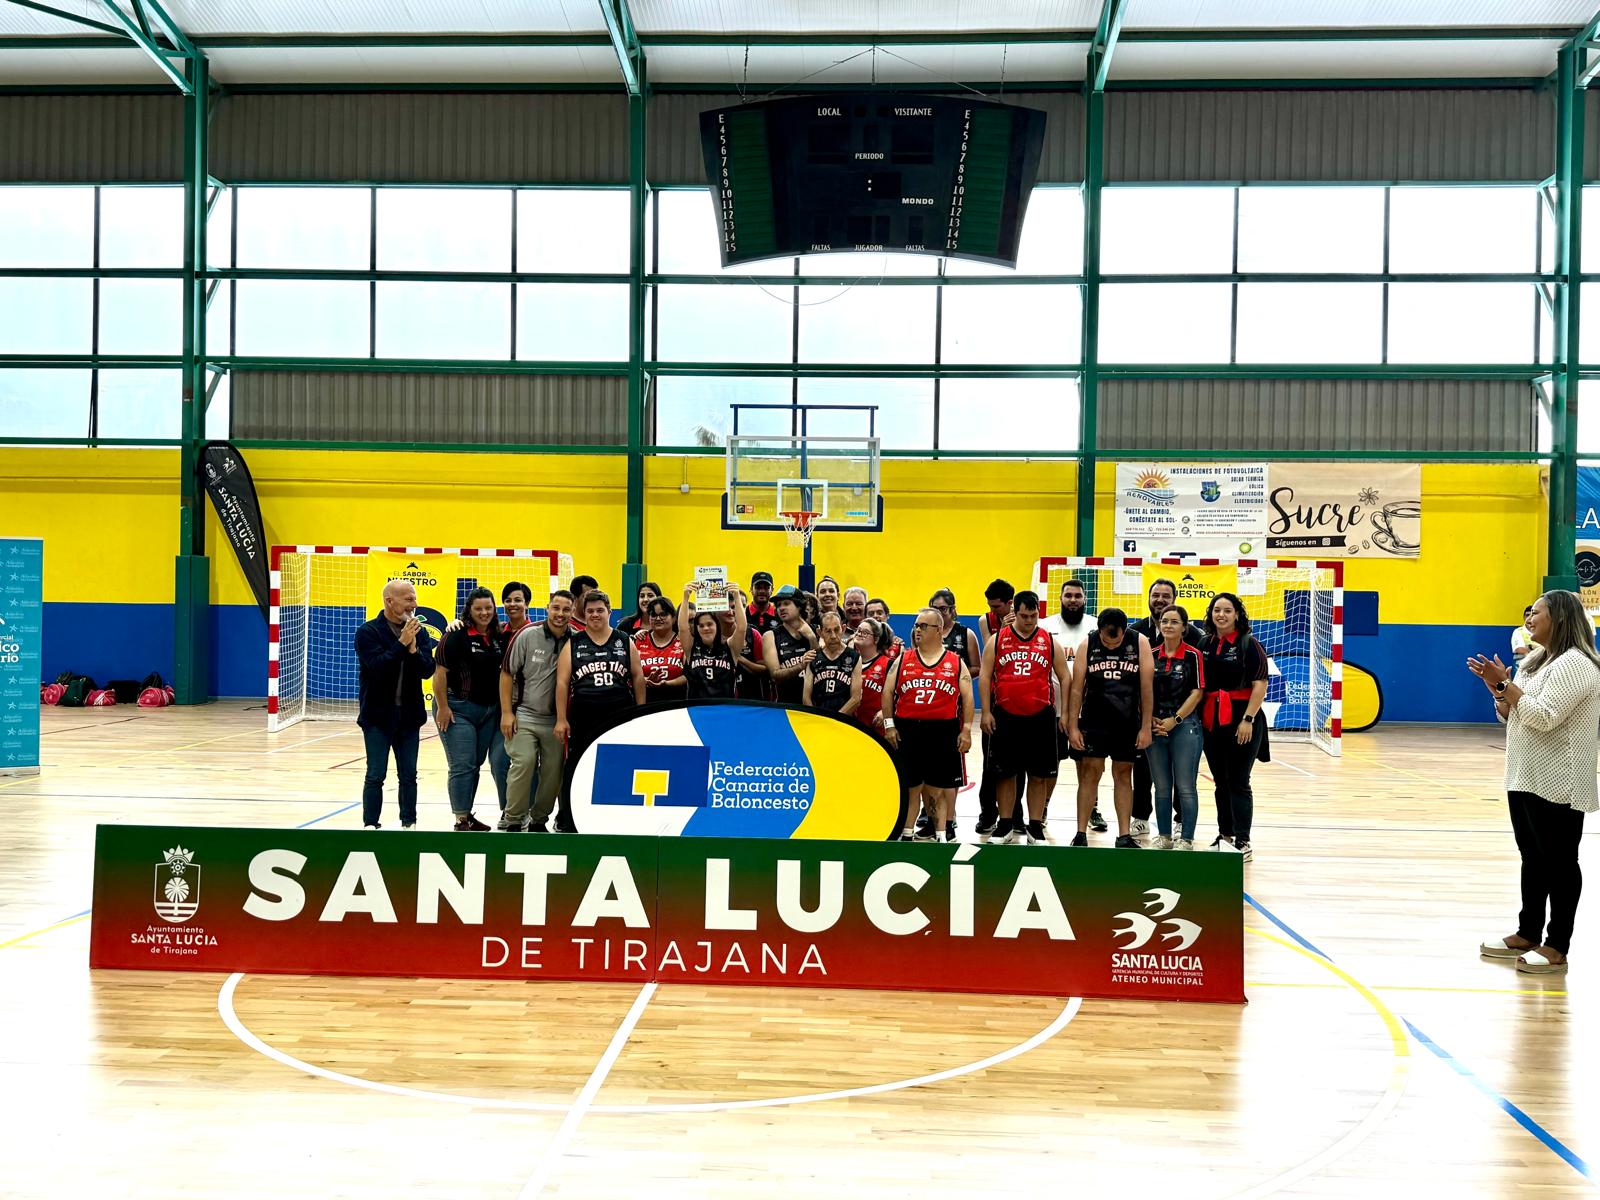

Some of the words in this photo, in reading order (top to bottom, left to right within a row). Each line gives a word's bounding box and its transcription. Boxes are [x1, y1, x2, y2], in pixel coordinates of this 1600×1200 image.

[817, 108, 841, 116] LOCAL
[894, 107, 932, 116] VISITANTE
[965, 110, 971, 119] E
[718, 114, 724, 123] E
[720, 125, 725, 134] 4
[964, 121, 969, 130] 4
[720, 135, 726, 144] 5
[963, 131, 969, 140] 5
[721, 146, 727, 155] 6
[962, 142, 967, 151] 6
[722, 156, 727, 166] 7
[960, 152, 966, 162] 7
[722, 168, 728, 177] 8
[959, 164, 964, 173] 8
[723, 179, 729, 188] 9
[958, 175, 963, 184] 9
[722, 189, 732, 198] 10
[953, 186, 964, 195] 10
[723, 199, 733, 209] 11
[952, 196, 962, 206] 11
[723, 210, 734, 220] 12
[950, 207, 962, 217] 12
[724, 221, 734, 230] 13
[949, 218, 960, 227] 13
[724, 232, 735, 241] 14
[947, 228, 959, 238] 14
[726, 242, 736, 252] 15
[946, 239, 957, 249] 15
[1126, 492, 1174, 507] RENOVABLES
[1269, 487, 1365, 534] Sucre
[218, 487, 239, 522] SANTA
[236, 522, 256, 559] LUCIA
[232, 495, 255, 542] Ayuntamiento
[1576, 507, 1600, 529] A
[221, 508, 227, 517] de
[226, 517, 240, 547] Tirajana
[1275, 538, 1306, 547] Síguenos
[387, 577, 437, 586] STRO
[640, 657, 664, 667] AGEC
[999, 652, 1027, 666] MAGEC
[576, 661, 606, 680] MAGEC
[1014, 662, 1031, 676] 52
[1088, 661, 1118, 672] MAGEC
[706, 668, 713, 680] 9
[594, 672, 613, 687] 60
[826, 679, 835, 693] 19
[901, 679, 932, 693] MAGEC
[915, 690, 936, 704] 27
[713, 761, 810, 777] Federación
[712, 778, 784, 792] Canaria
[788, 779, 809, 793] de
[711, 793, 810, 810] Baloncesto
[242, 849, 650, 928] SANTA
[704, 843, 1076, 940] LUCÍA
[147, 925, 204, 934] Ayuntamiento
[131, 934, 171, 945] SANTA
[176, 934, 218, 946] LUCIA
[150, 946, 160, 954] de
[163, 946, 198, 955] Tirajana
[482, 937, 542, 968] DE
[571, 938, 827, 975] TIRAJANA
[1111, 953, 1158, 968] SANTA
[1161, 954, 1202, 971] LUCIA
[1112, 975, 1148, 983] ATENEO
[1152, 977, 1204, 985] MUNICIPAL
